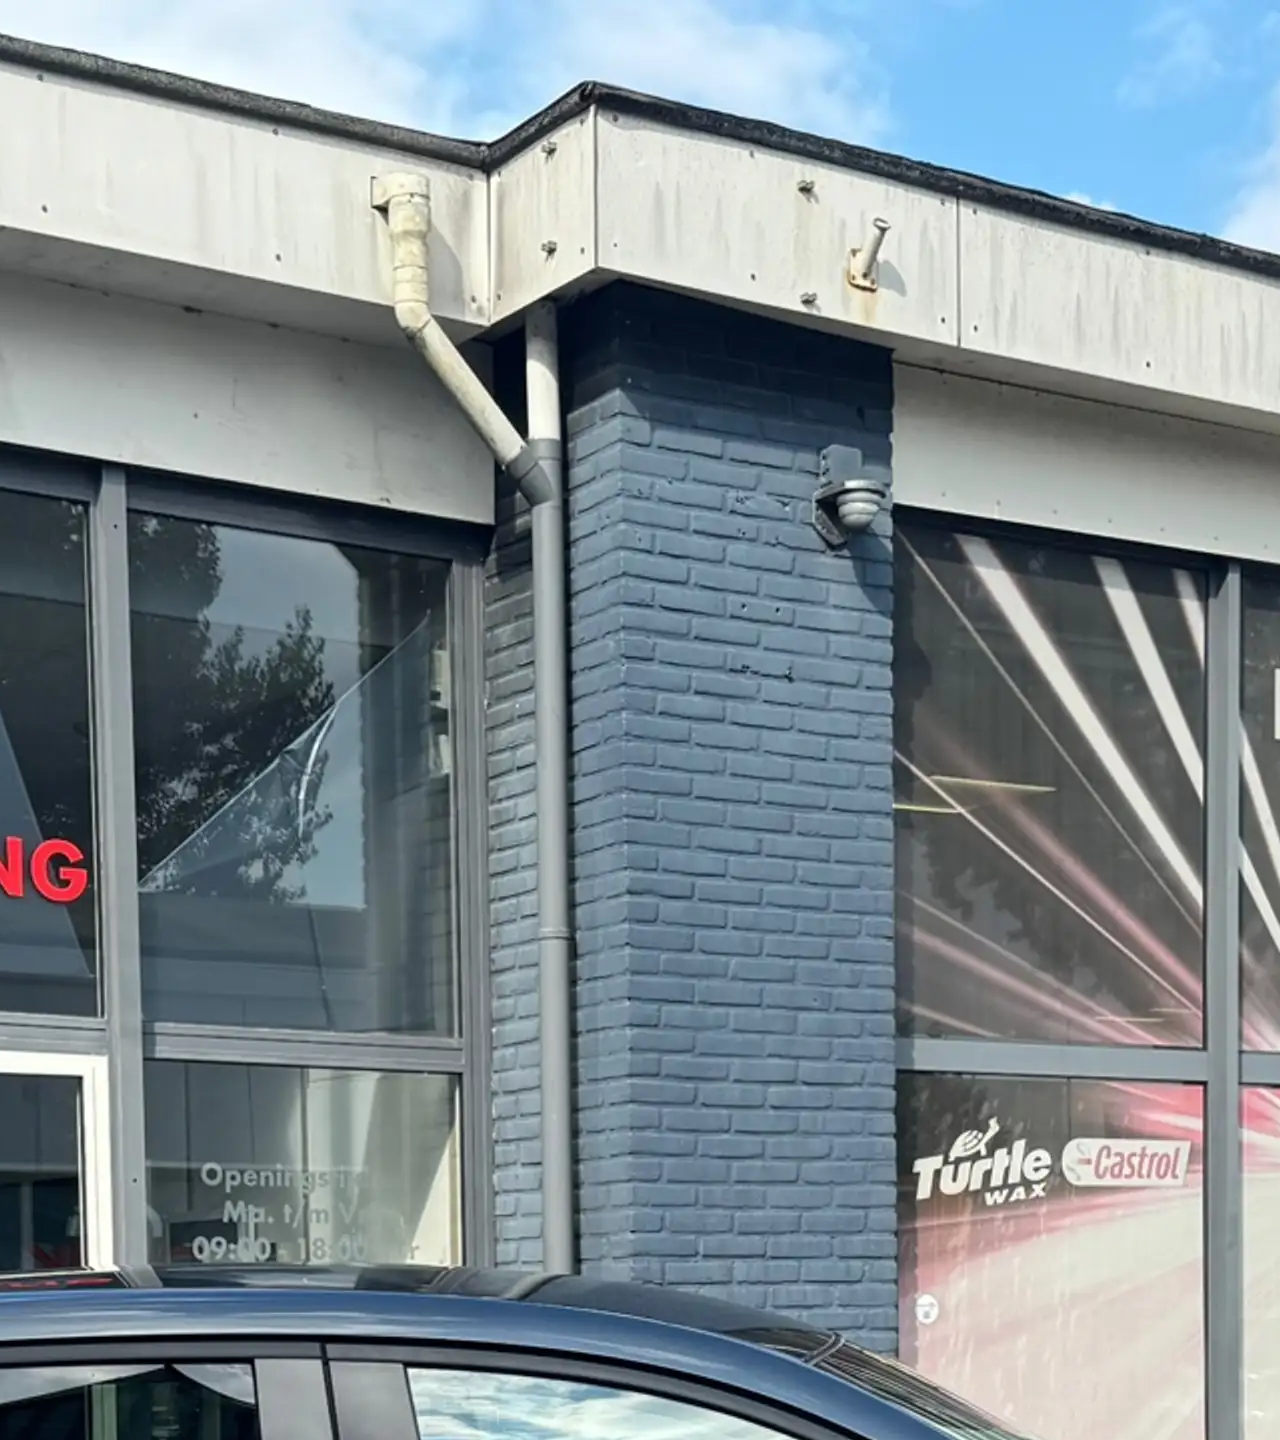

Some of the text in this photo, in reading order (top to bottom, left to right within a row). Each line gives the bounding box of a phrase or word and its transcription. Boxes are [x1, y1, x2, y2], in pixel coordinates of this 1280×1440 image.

[912, 1137, 1052, 1201] Turtle
[1093, 1144, 1181, 1180] Castrol
[984, 1183, 1047, 1207] WAX
[191, 1236, 271, 1262] 09:00
